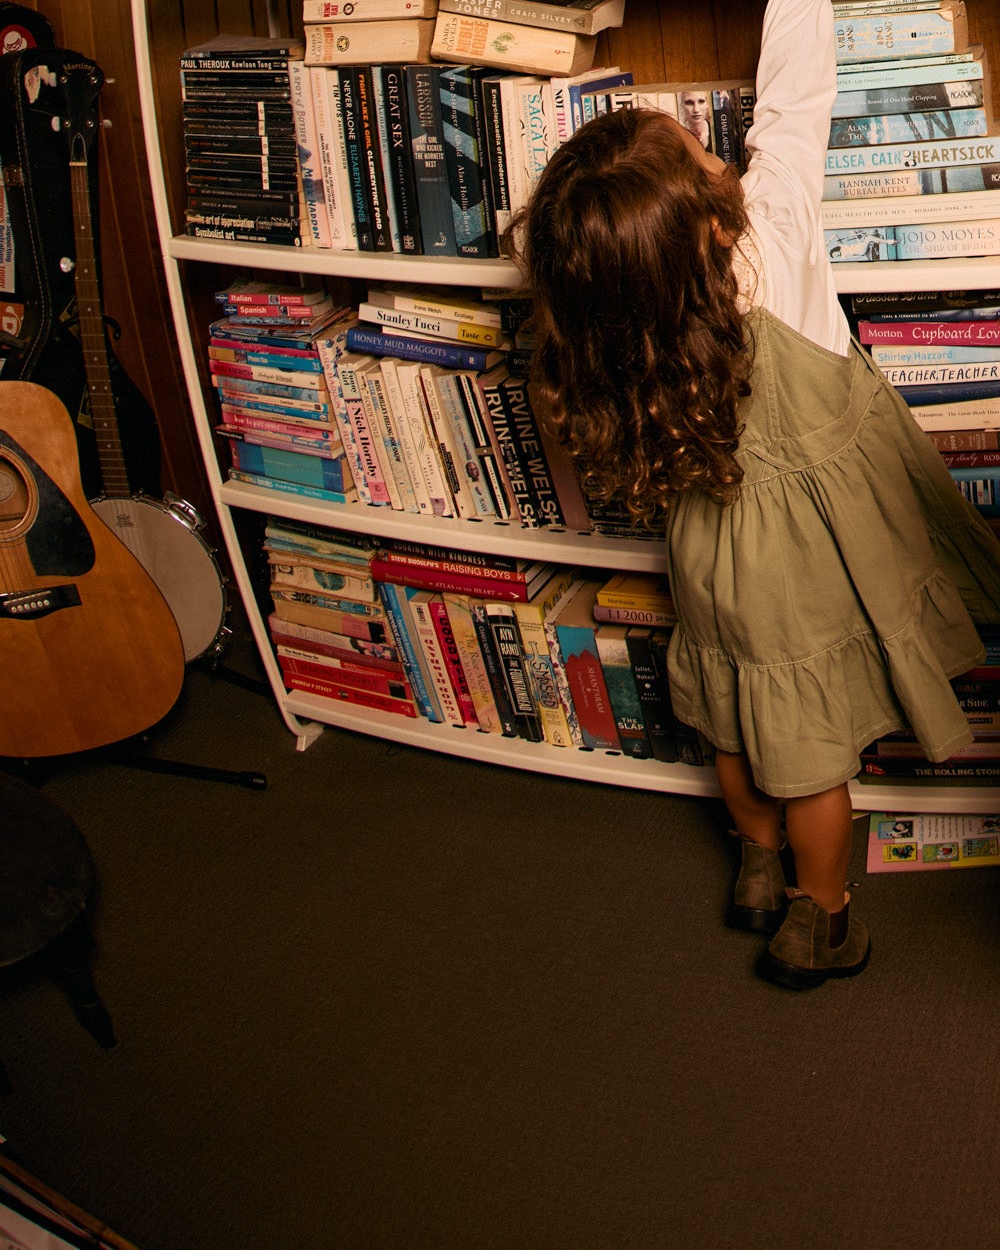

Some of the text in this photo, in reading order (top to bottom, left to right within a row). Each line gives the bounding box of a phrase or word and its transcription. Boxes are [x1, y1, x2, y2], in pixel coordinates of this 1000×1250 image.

[456, 4, 498, 17] JONES
[511, 9, 572, 24] CRAIG SILVEY
[180, 60, 230, 68] PAUL THEROUX
[912, 145, 994, 163] HEARTSICK
[903, 228, 995, 245] JOJO MOYES
[376, 310, 441, 332] Stanley Tucci
[461, 329, 480, 340] Taste
[868, 329, 903, 338] Morton
[912, 325, 972, 343] Cupboard
[353, 405, 377, 478] Nick Hornby
[505, 383, 563, 527] IRVINE WELSH
[443, 562, 510, 580] RAISING BOYS
[617, 722, 644, 730] SLAP
